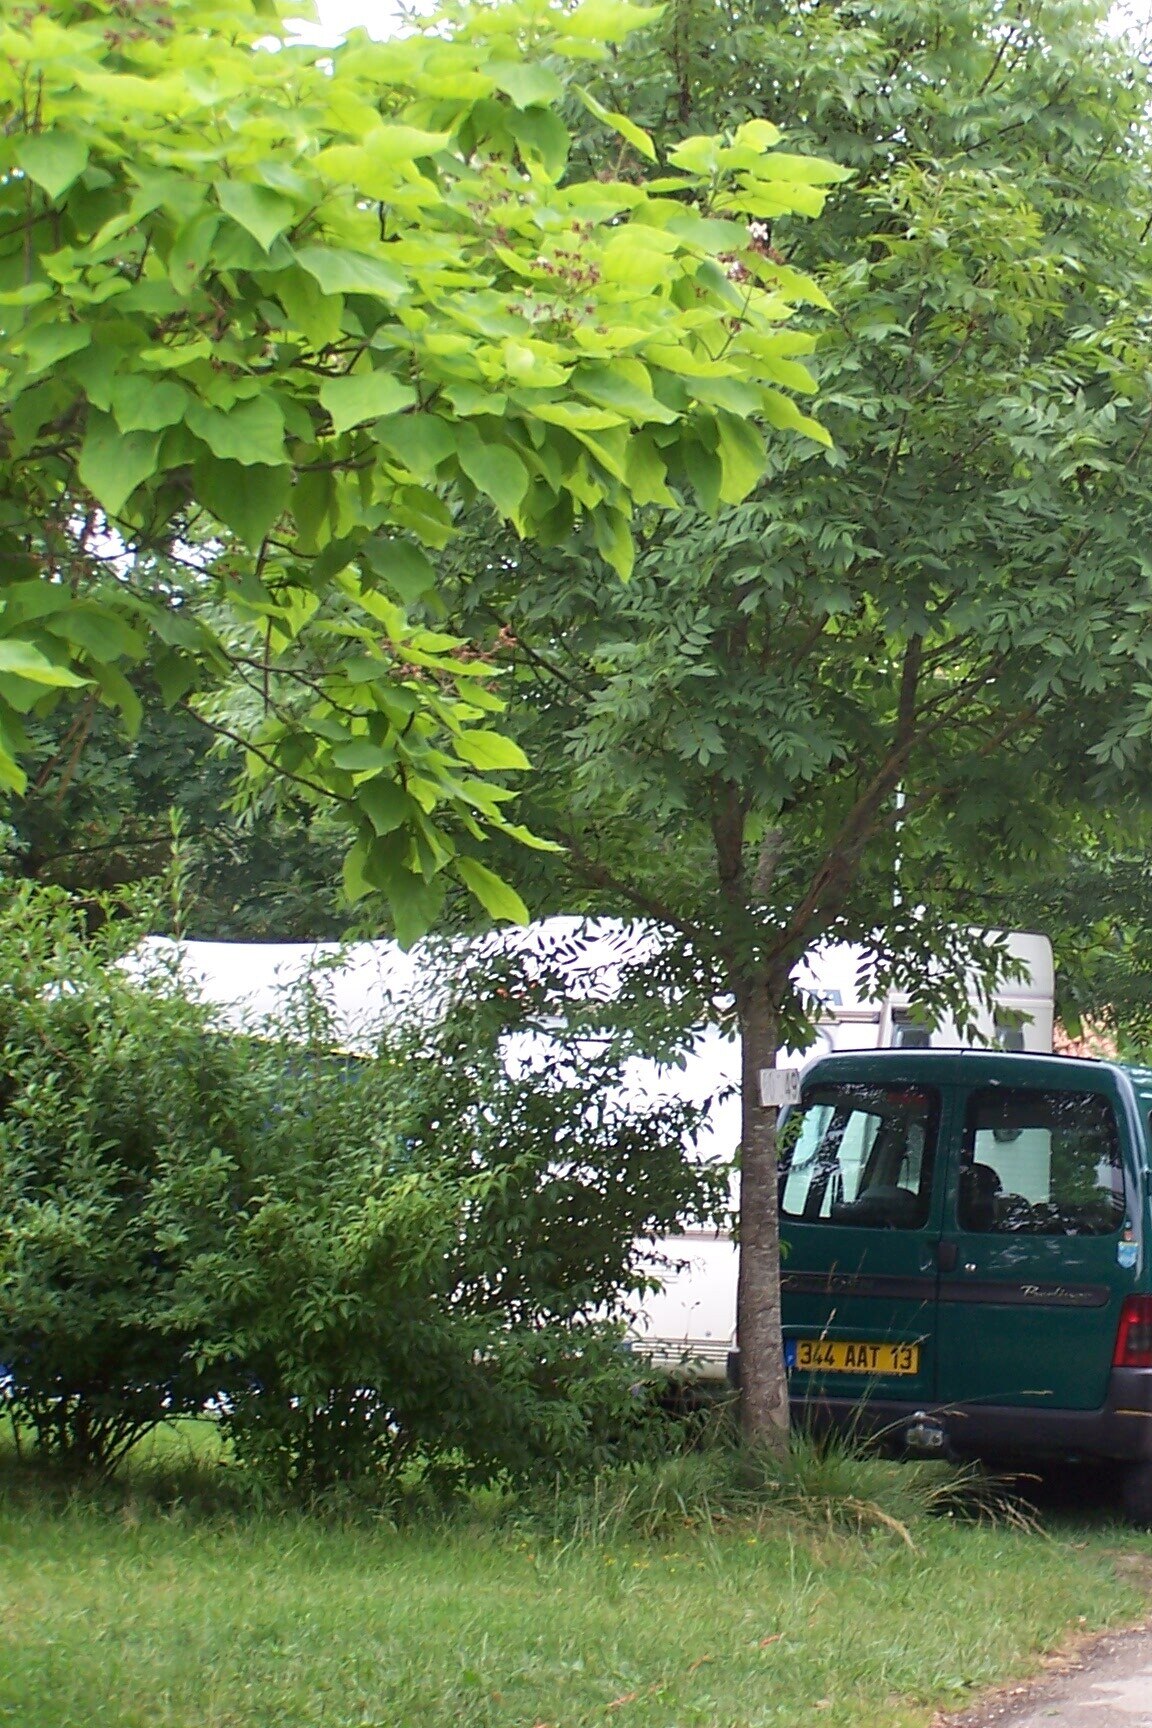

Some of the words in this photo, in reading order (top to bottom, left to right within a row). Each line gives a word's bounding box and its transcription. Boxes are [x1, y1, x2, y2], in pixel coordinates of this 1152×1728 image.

[799, 1343, 836, 1366] 344
[845, 1345, 881, 1368] AAT
[890, 1347, 913, 1370] 13
